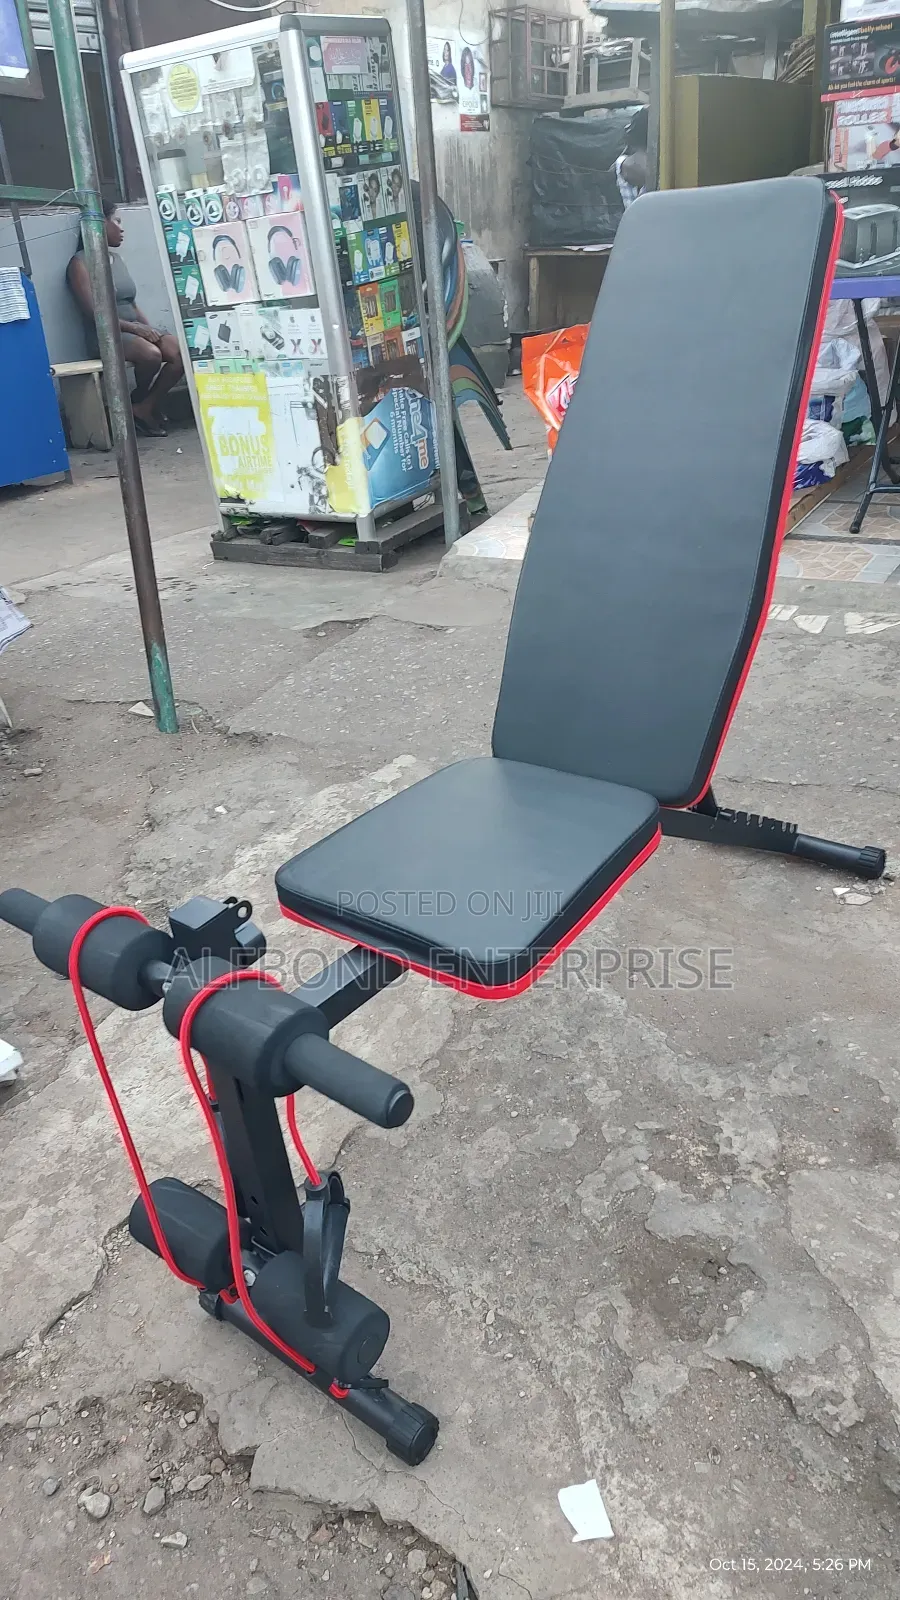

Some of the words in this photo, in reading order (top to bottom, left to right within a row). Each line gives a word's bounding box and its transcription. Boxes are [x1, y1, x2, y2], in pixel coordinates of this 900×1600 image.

[219, 435, 270, 456] BONUS
[391, 419, 399, 454] months
[397, 420, 405, 457] Number
